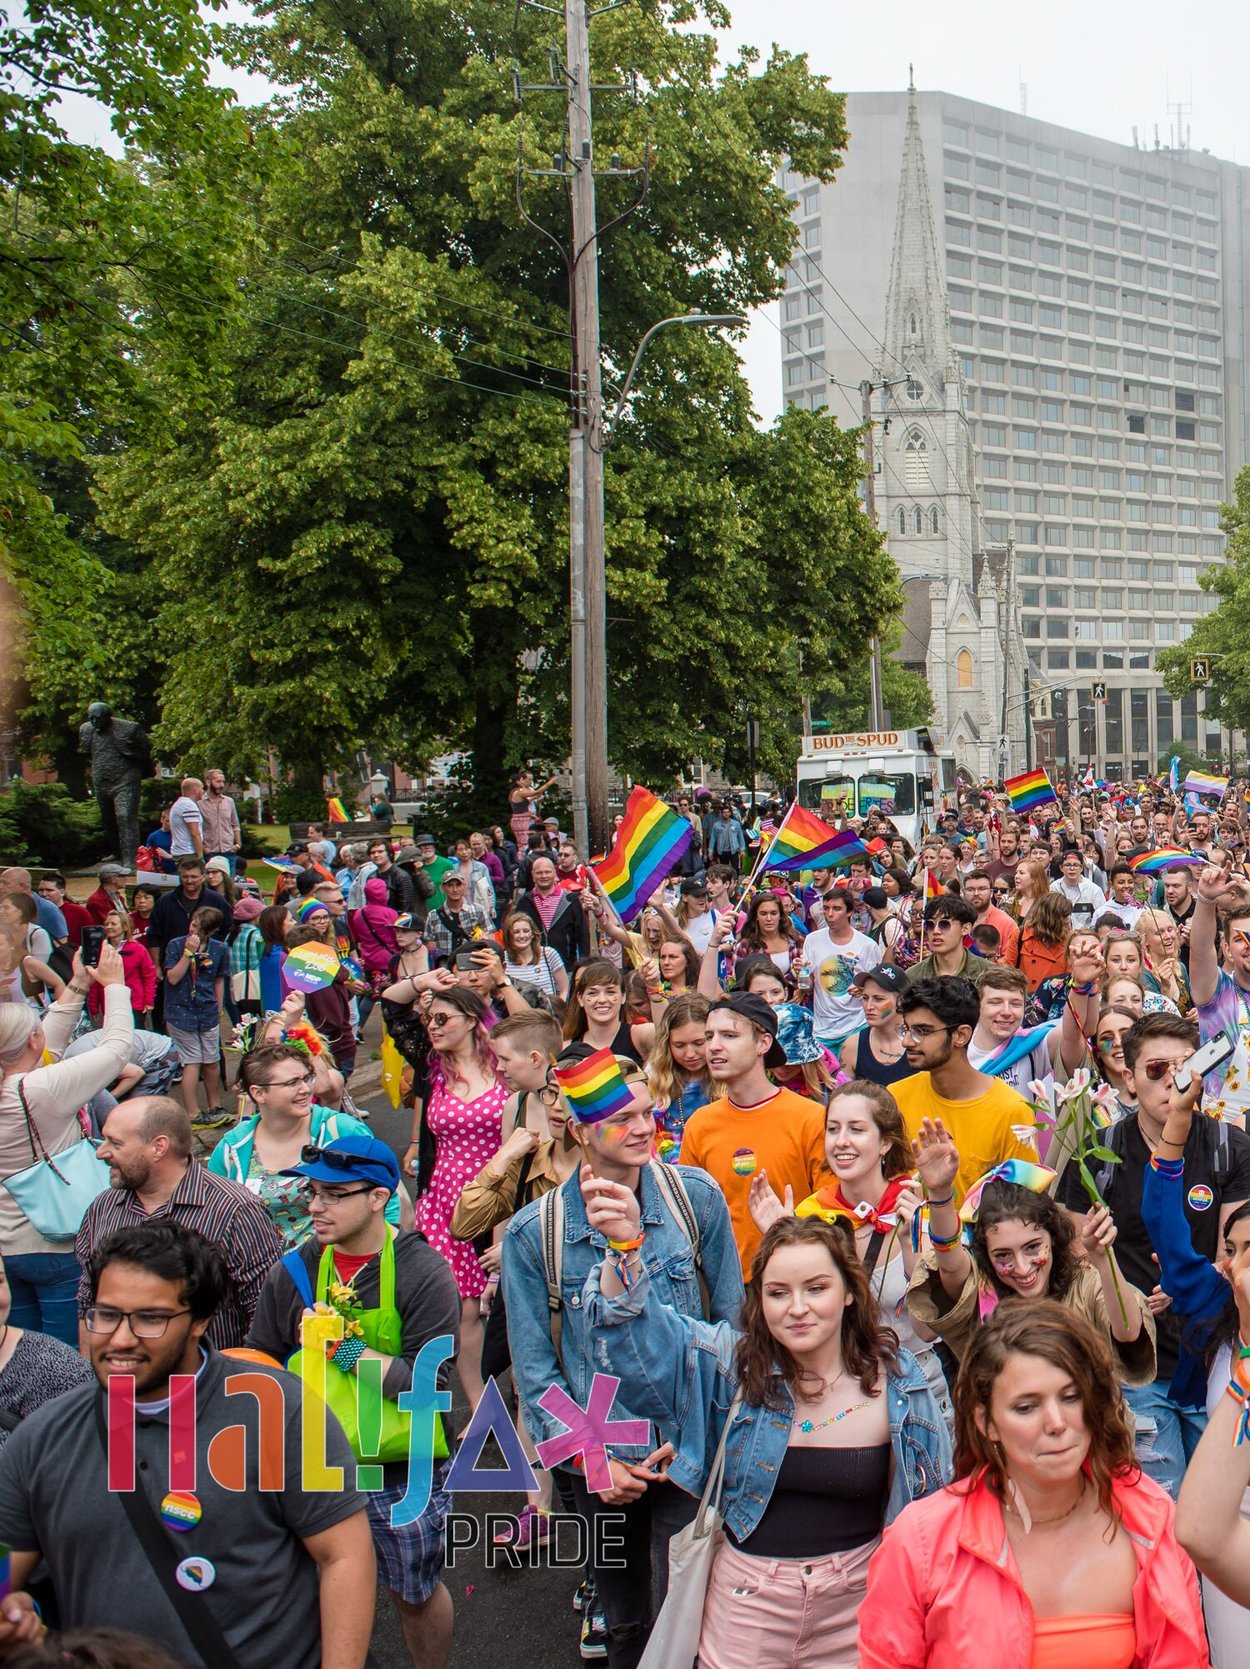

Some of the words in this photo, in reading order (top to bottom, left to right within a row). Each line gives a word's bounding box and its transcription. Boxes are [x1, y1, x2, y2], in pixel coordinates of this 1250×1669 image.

[813, 736, 845, 750] BUD
[856, 732, 898, 747] SPUD
[164, 1503, 196, 1520] nscc
